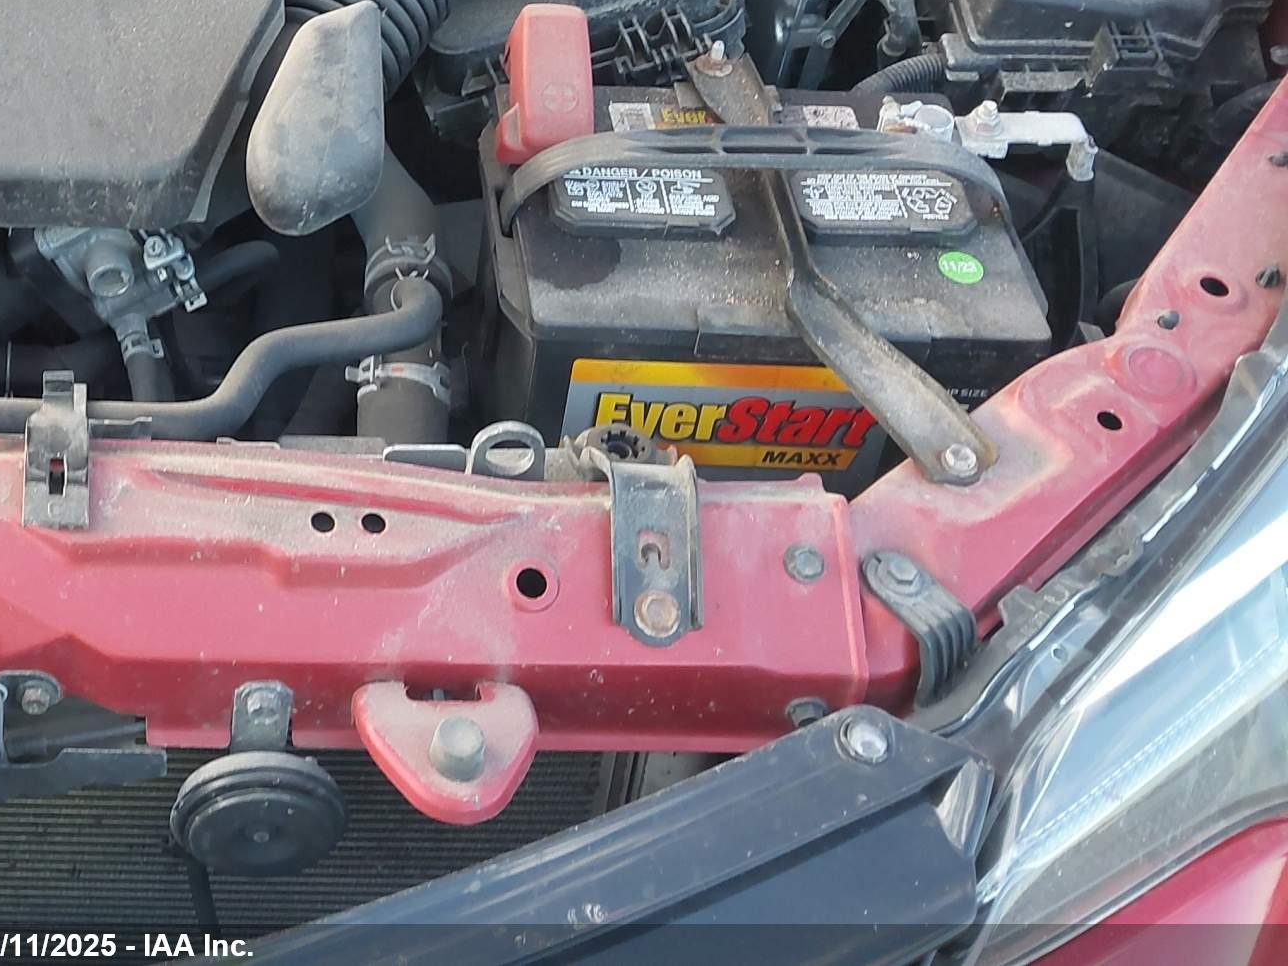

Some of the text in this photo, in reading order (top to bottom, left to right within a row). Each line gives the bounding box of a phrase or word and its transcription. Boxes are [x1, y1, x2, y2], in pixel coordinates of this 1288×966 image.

[582, 166, 638, 178] DANGER
[651, 168, 702, 180] POISON
[594, 392, 877, 448] EverStart
[762, 449, 842, 467] MAXX
